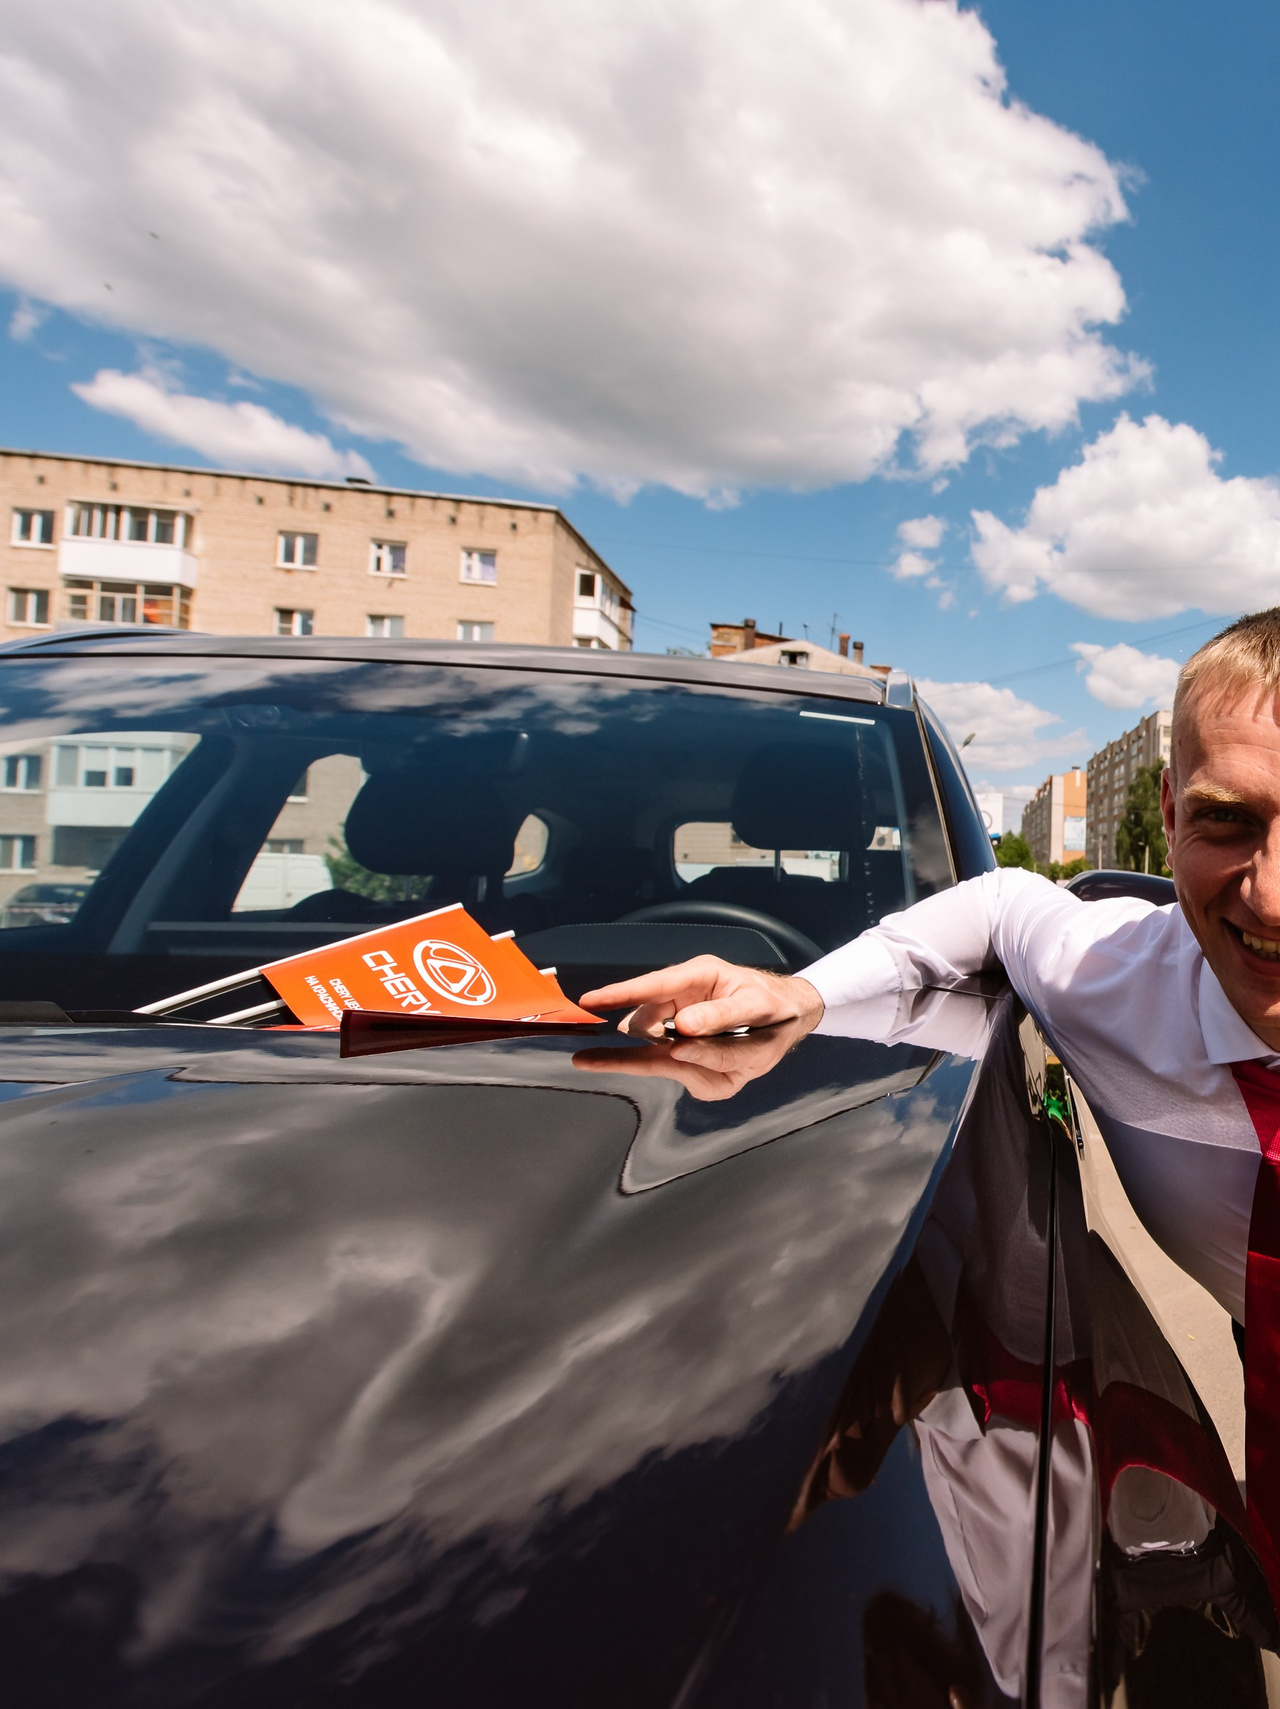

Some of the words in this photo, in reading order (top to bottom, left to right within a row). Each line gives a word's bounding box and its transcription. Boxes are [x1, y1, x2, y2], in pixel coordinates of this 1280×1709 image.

[304, 975, 319, 987] НА
[362, 950, 442, 1014] CHERY
[343, 998, 364, 1011] ЦЕН
